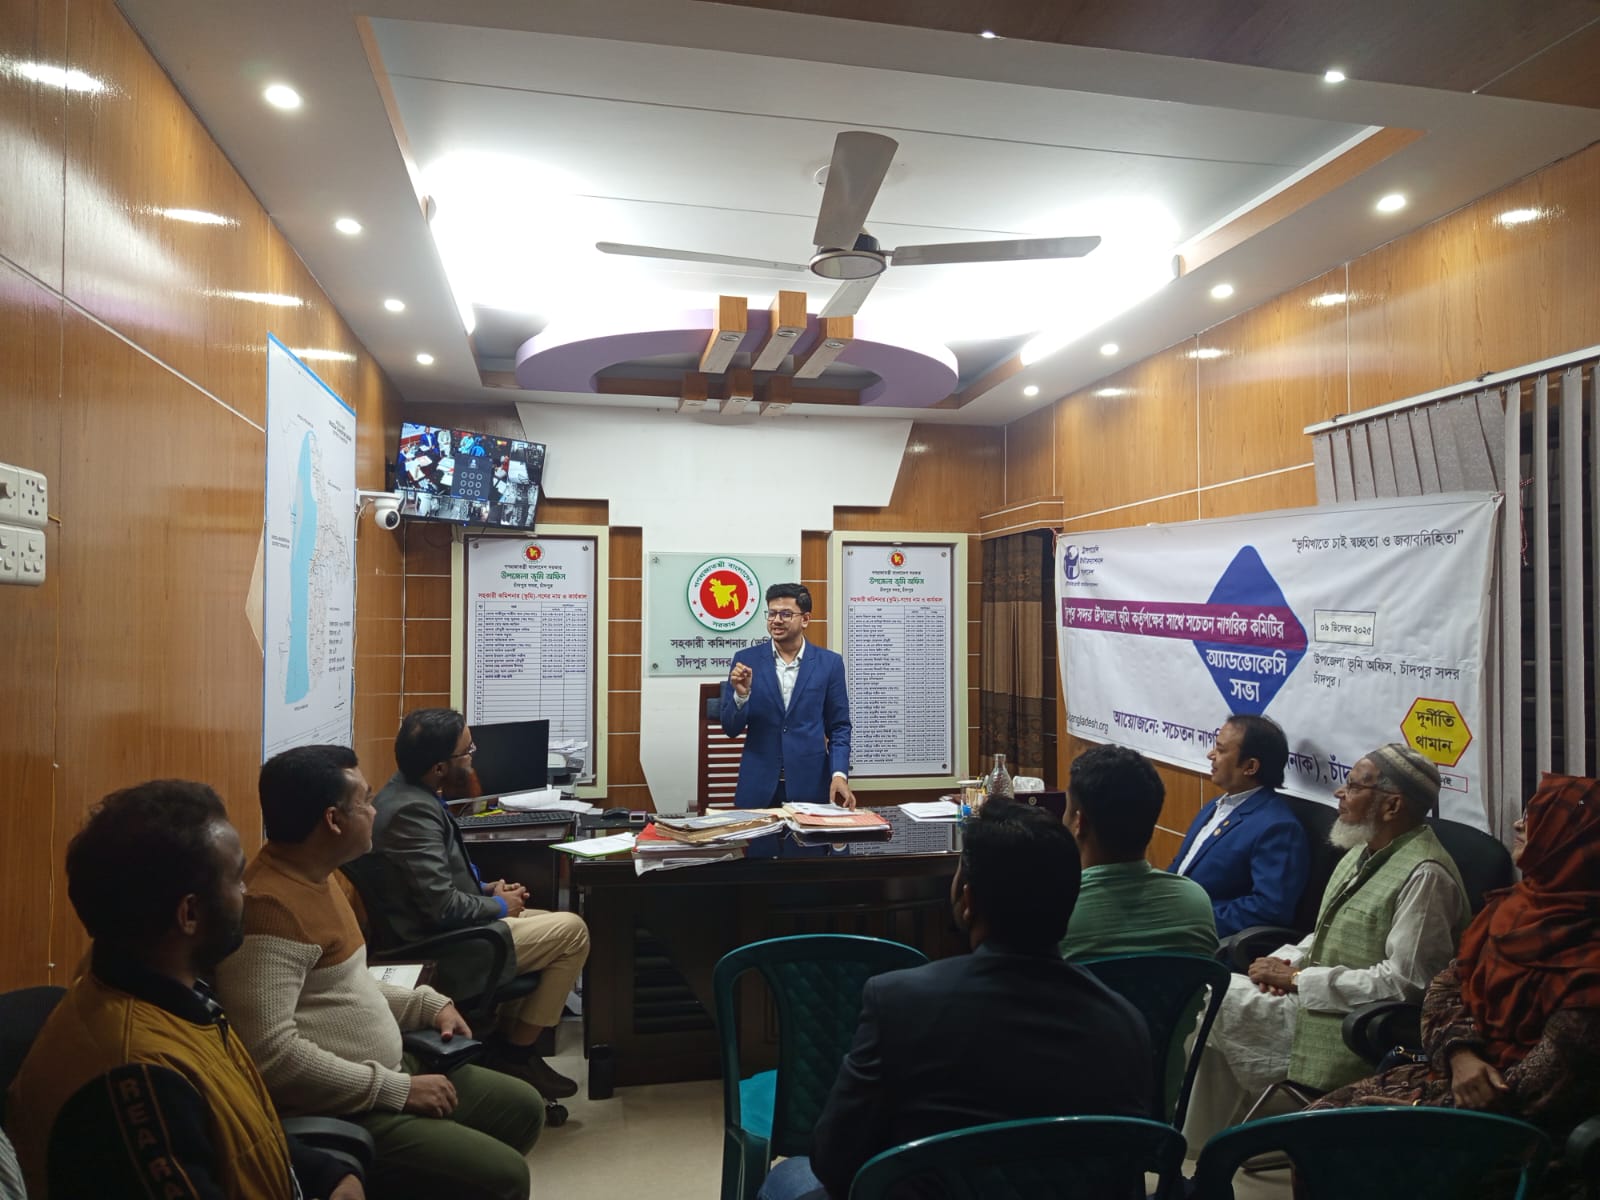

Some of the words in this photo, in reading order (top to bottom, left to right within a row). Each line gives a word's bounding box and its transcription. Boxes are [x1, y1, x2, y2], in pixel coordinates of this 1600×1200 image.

[1331, 535, 1348, 550] চাই
[1350, 536, 1379, 550] স্বচ্ছতা
[1381, 539, 1391, 547] ও
[501, 571, 529, 580] উপজেলা
[530, 571, 544, 582] ভূমি
[546, 571, 566, 580] অফিস
[728, 563, 754, 587] বাংলাদেশ
[712, 620, 736, 628] সরকার
[1077, 607, 1093, 622] সদর
[1094, 604, 1118, 625] উপজেলা
[1118, 606, 1130, 632] ভূমি
[1166, 613, 1185, 631] সাথে
[1186, 615, 1215, 635] সচেতন
[1216, 612, 1249, 636] নাগরিক
[1250, 613, 1285, 640] কমিটির
[670, 636, 705, 649] সহকারী
[707, 636, 747, 649] কমিশনার
[675, 654, 707, 671] চাঁদপুর
[710, 657, 733, 669] সদর
[1206, 649, 1288, 676] অ্যাডভোকেসি
[1313, 652, 1345, 666] উপজেলা
[1347, 655, 1363, 673] ভূমি
[1400, 660, 1432, 680] চাঁদপুর
[1434, 666, 1460, 680] সদর
[1229, 678, 1260, 702] সভা
[1415, 708, 1457, 730] দুর্নীতি
[1162, 721, 1195, 745] সচেতন
[1416, 736, 1453, 753] থামান
